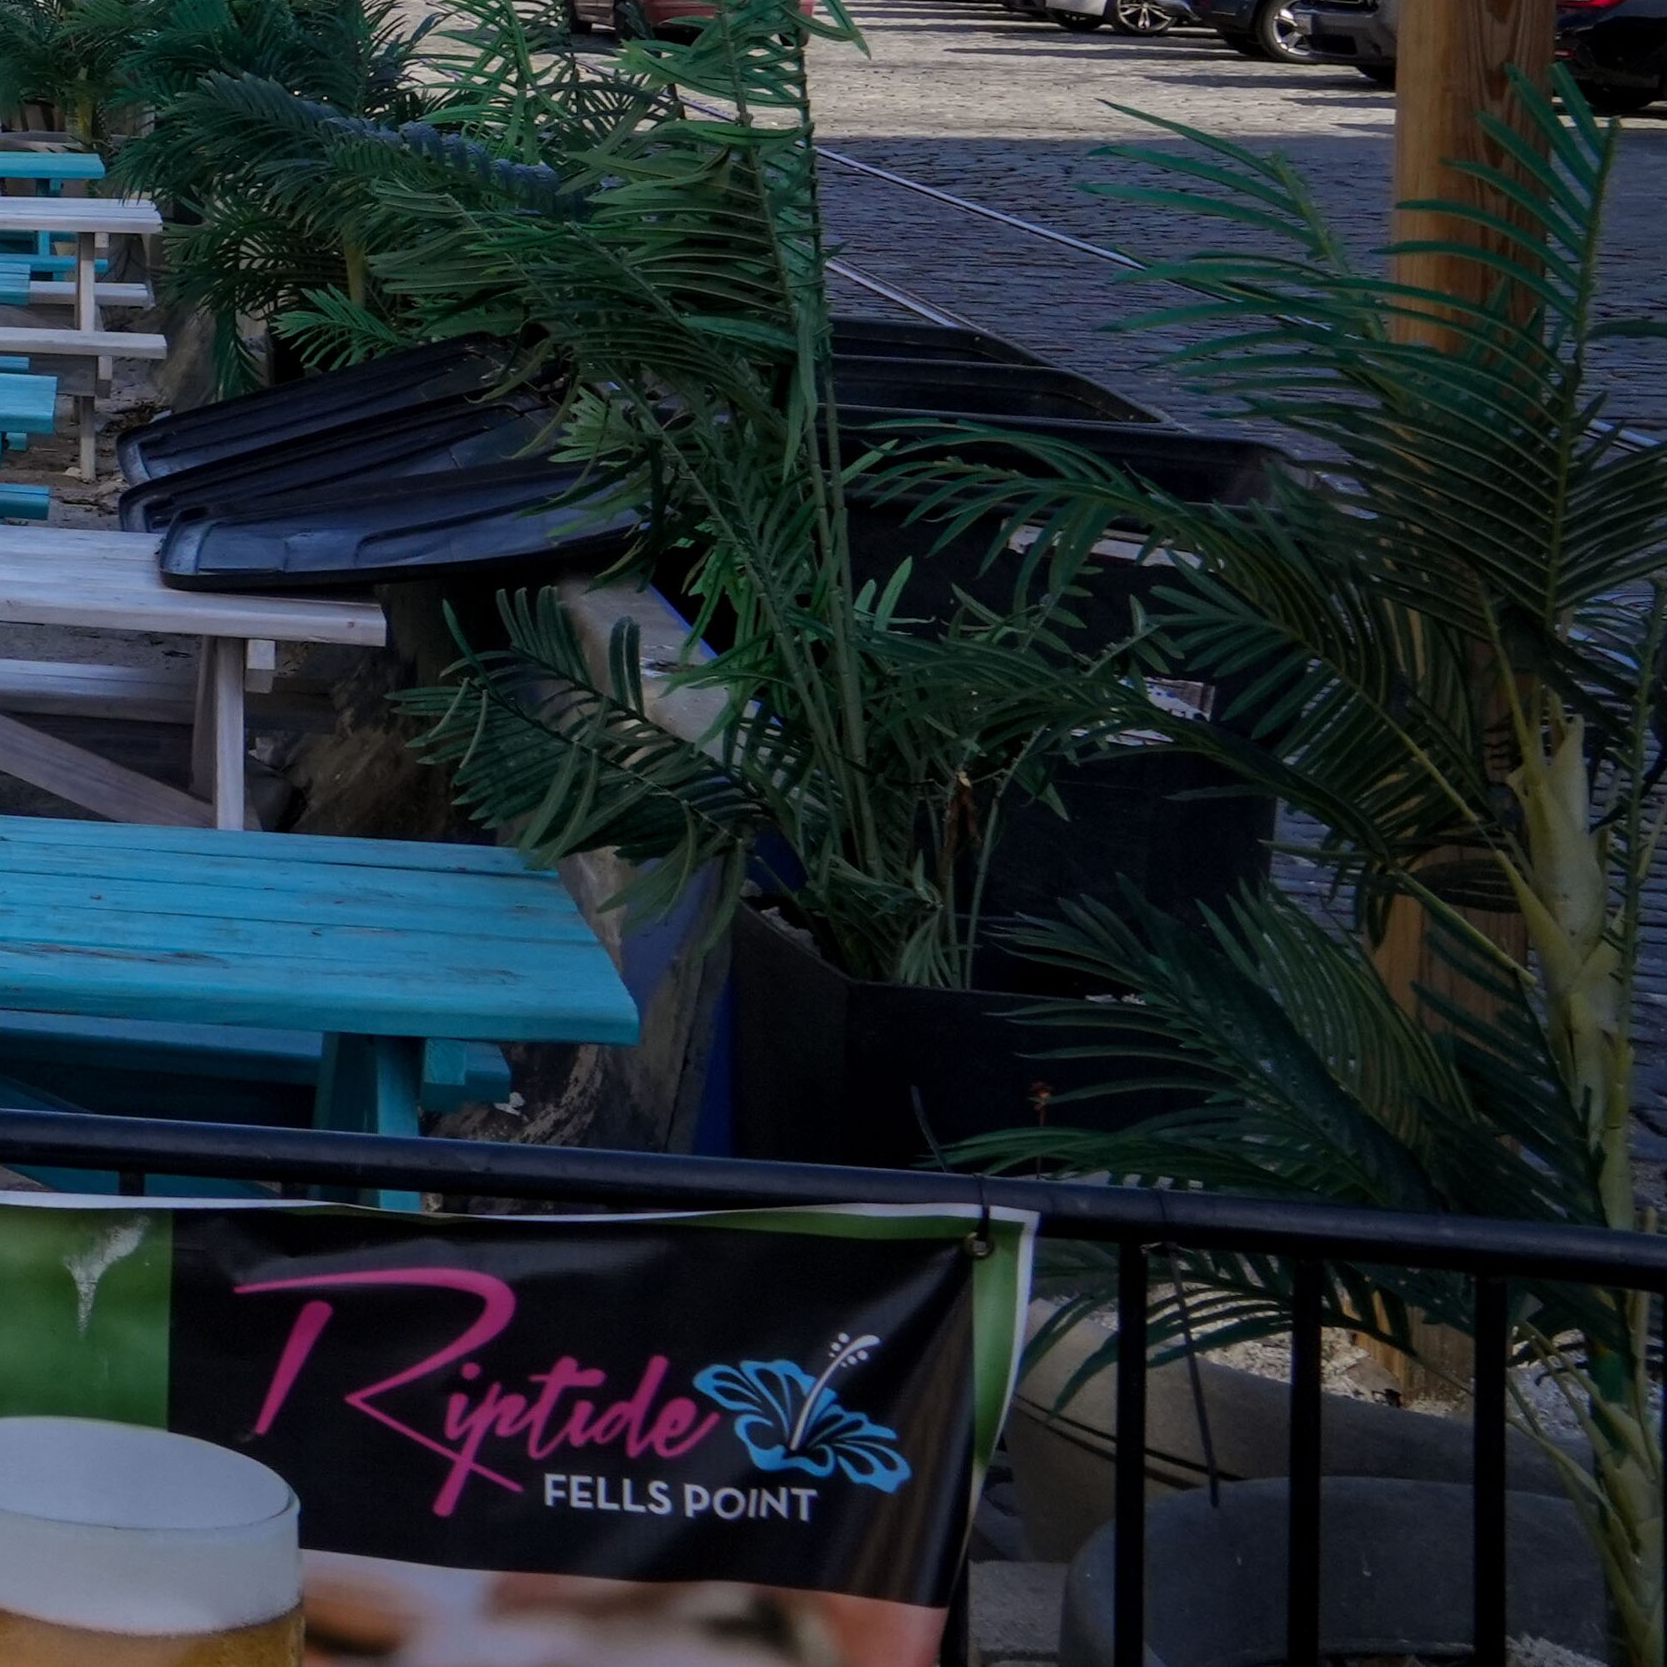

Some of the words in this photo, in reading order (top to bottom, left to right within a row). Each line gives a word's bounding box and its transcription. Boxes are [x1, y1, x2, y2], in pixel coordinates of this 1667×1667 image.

[235, 1267, 720, 1518] Riptide
[543, 1473, 671, 1518] FELLS
[684, 1482, 819, 1524] POINT
